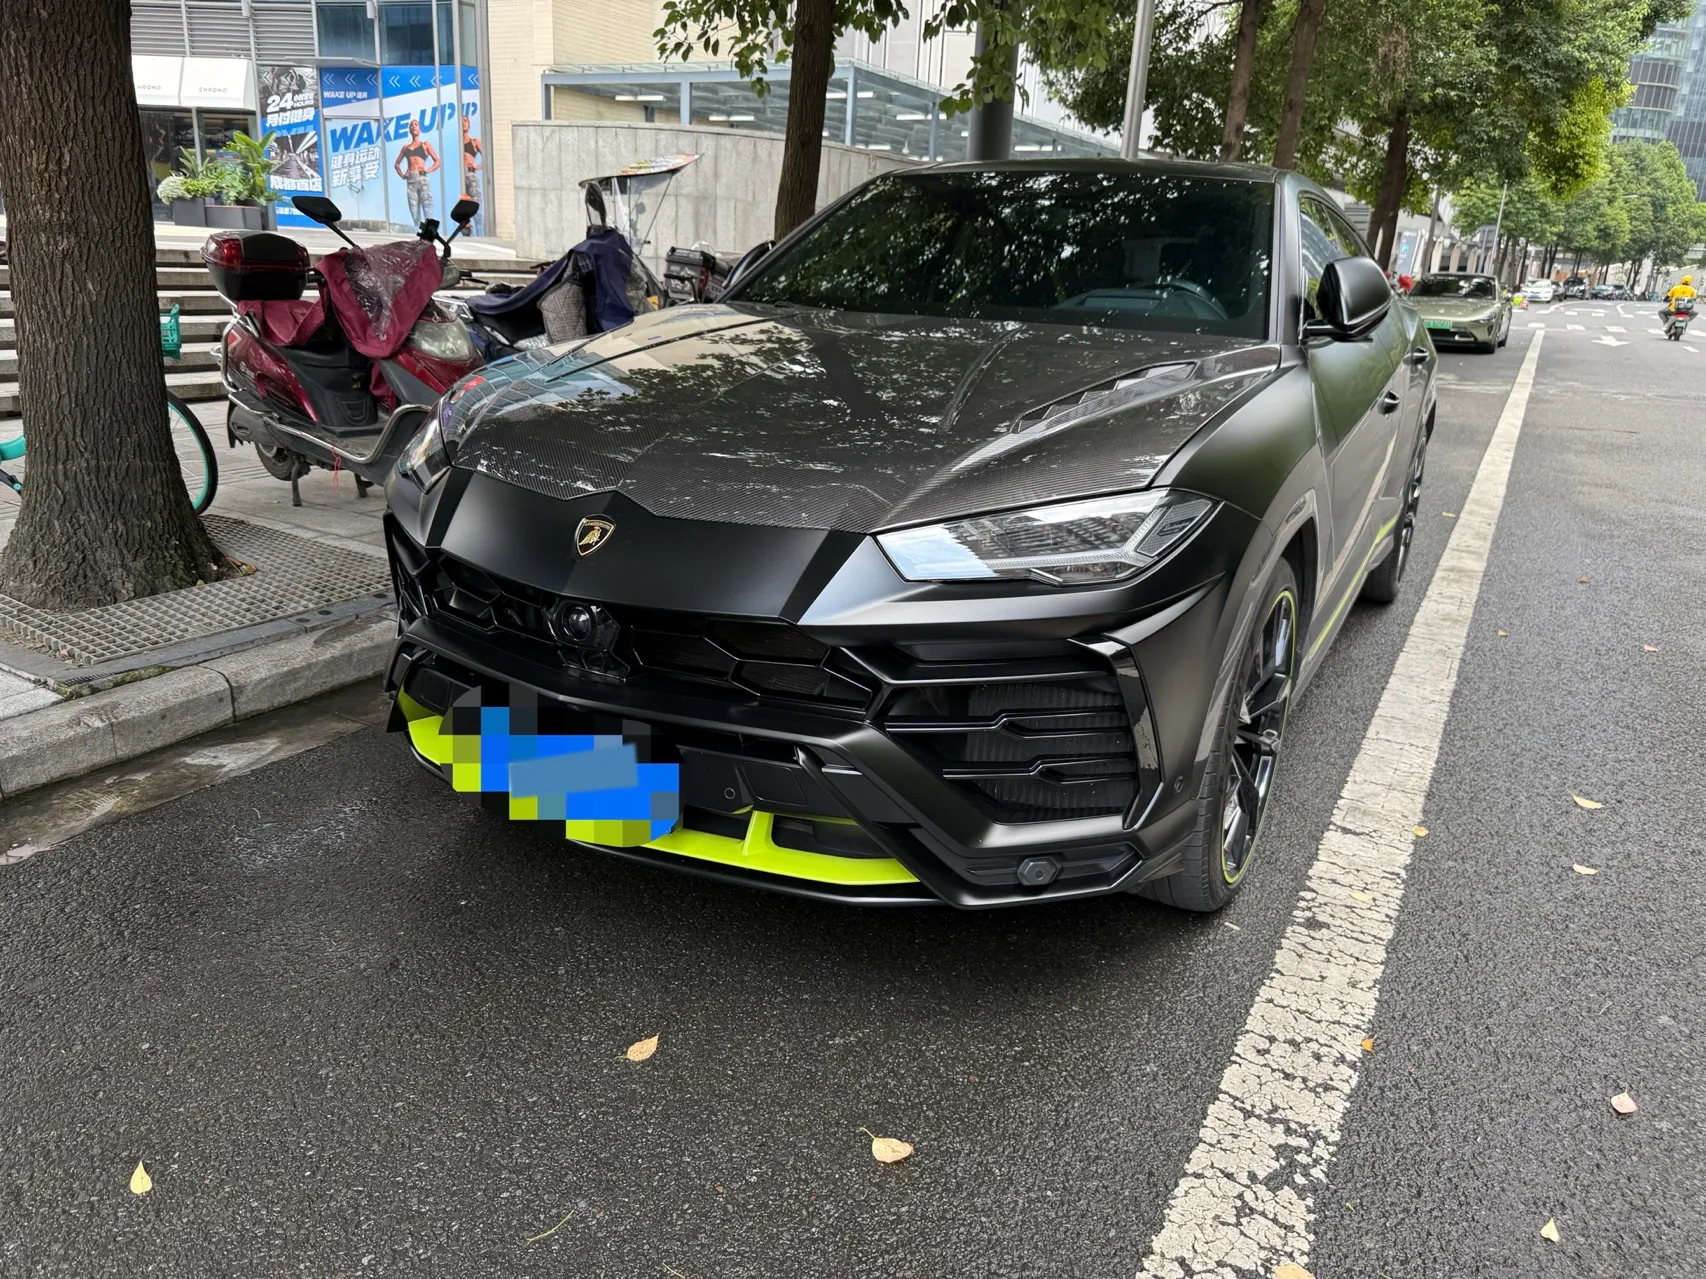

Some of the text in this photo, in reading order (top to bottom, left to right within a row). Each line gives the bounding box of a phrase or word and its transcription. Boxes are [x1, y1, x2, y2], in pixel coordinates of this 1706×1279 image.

[267, 92, 293, 113] 24
[323, 91, 345, 99] WAKE
[346, 91, 356, 99] UP
[330, 102, 456, 153] WAKE UP
[331, 147, 380, 169] 健身运动
[270, 175, 322, 192] 成都首店
[331, 160, 379, 187] 新享受
